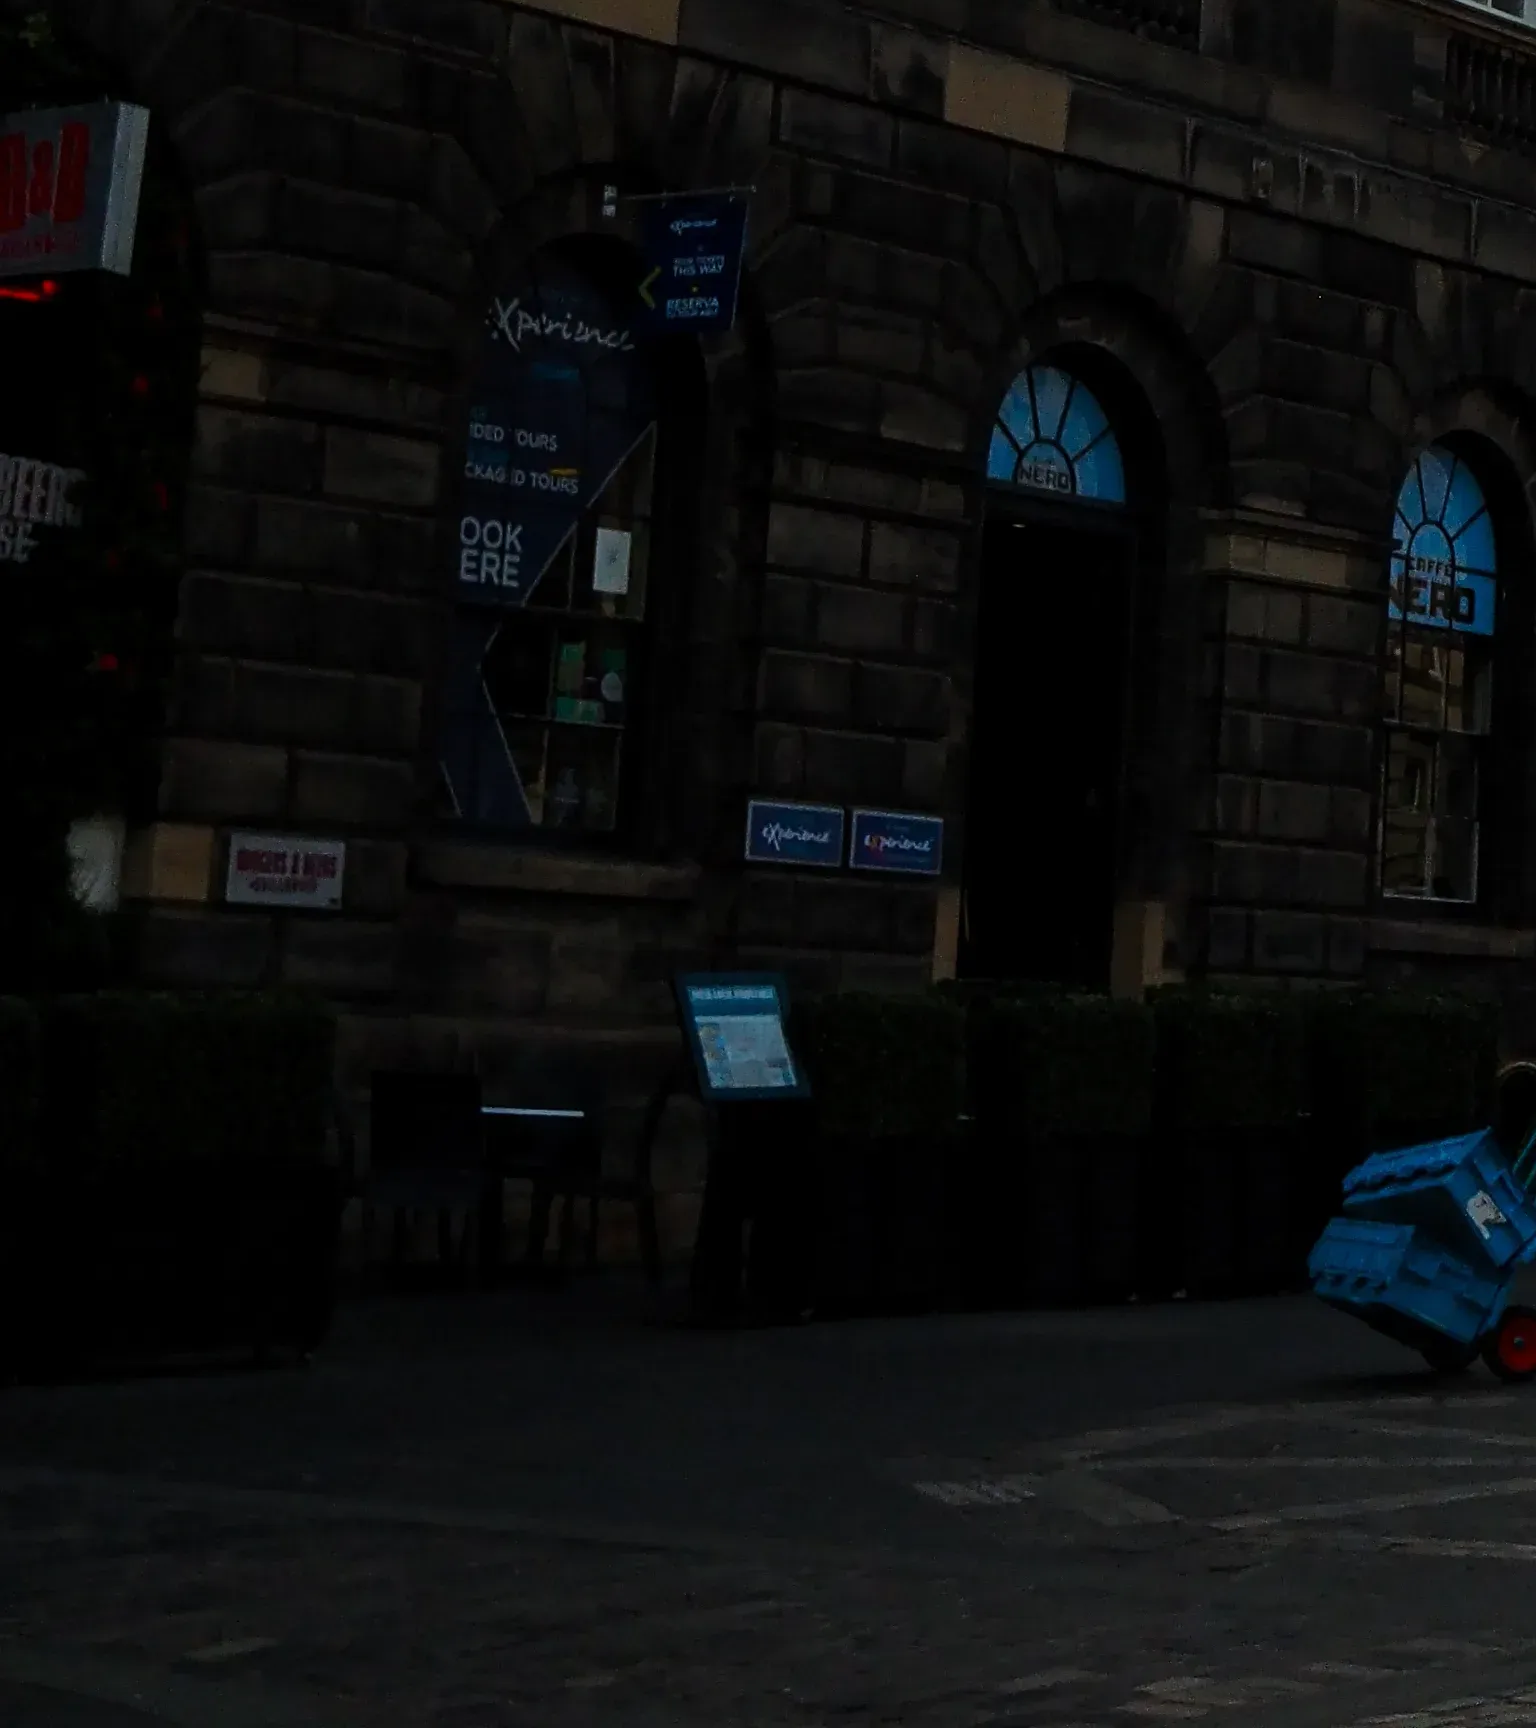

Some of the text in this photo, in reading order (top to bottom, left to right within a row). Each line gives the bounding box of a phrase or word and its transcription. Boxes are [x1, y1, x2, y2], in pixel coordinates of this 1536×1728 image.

[468, 421, 560, 453] IDED OURS
[463, 460, 580, 497] CKAGD TOURS
[1020, 465, 1069, 490] NERO
[459, 515, 524, 554] OOK
[458, 547, 521, 589] ERE
[1390, 573, 1476, 624] NERO
